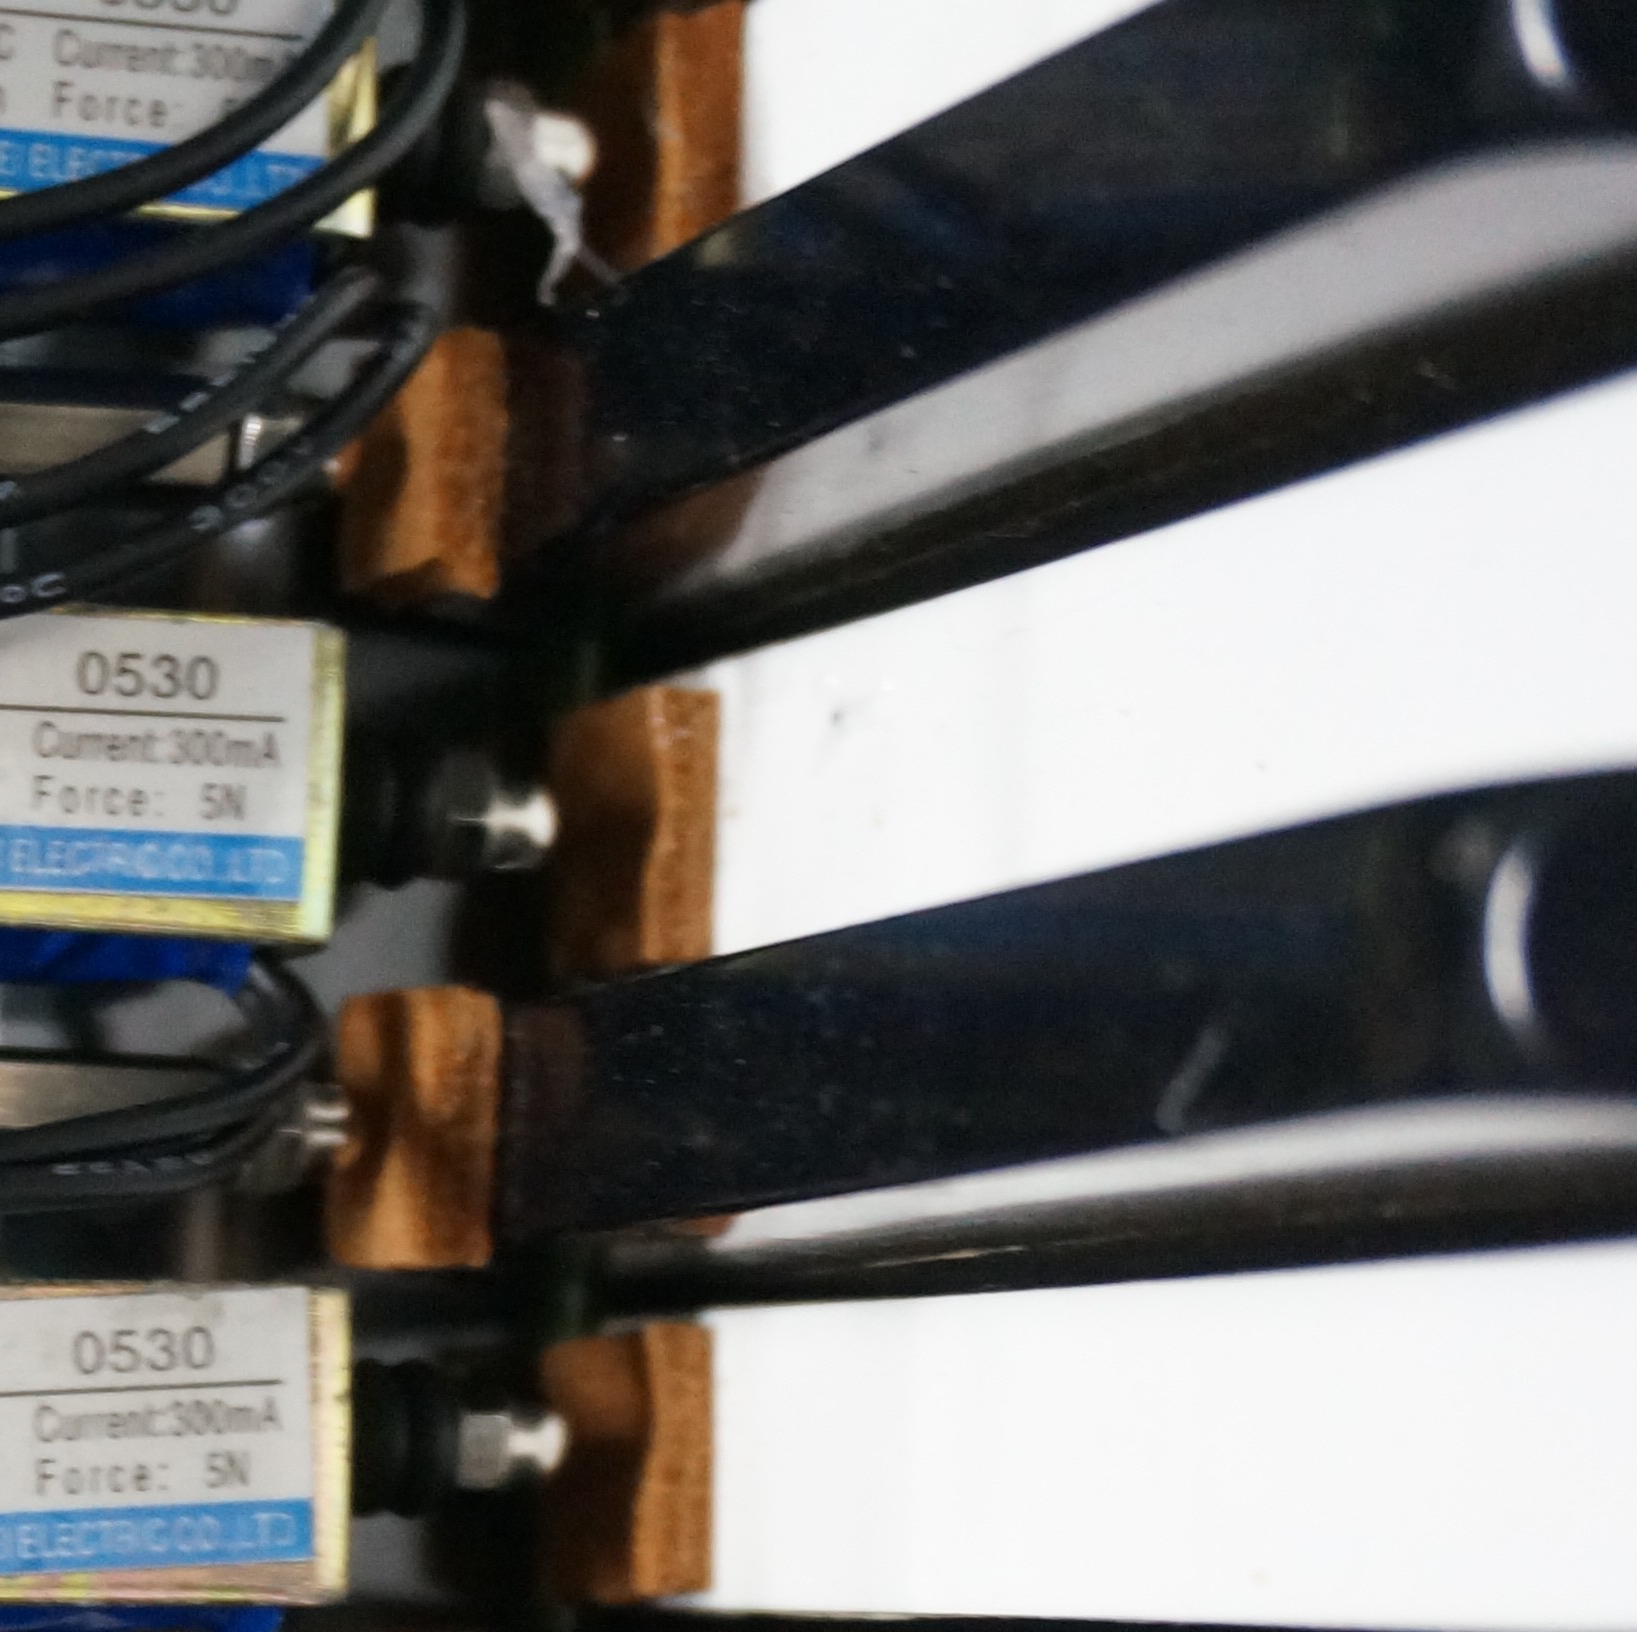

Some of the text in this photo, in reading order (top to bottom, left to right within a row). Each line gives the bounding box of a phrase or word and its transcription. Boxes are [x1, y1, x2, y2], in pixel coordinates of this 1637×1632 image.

[76, 650, 220, 701] 0530
[34, 774, 248, 823] Force: 5N
[73, 1325, 215, 1376] 0530
[34, 1451, 250, 1498] Force: 5N
